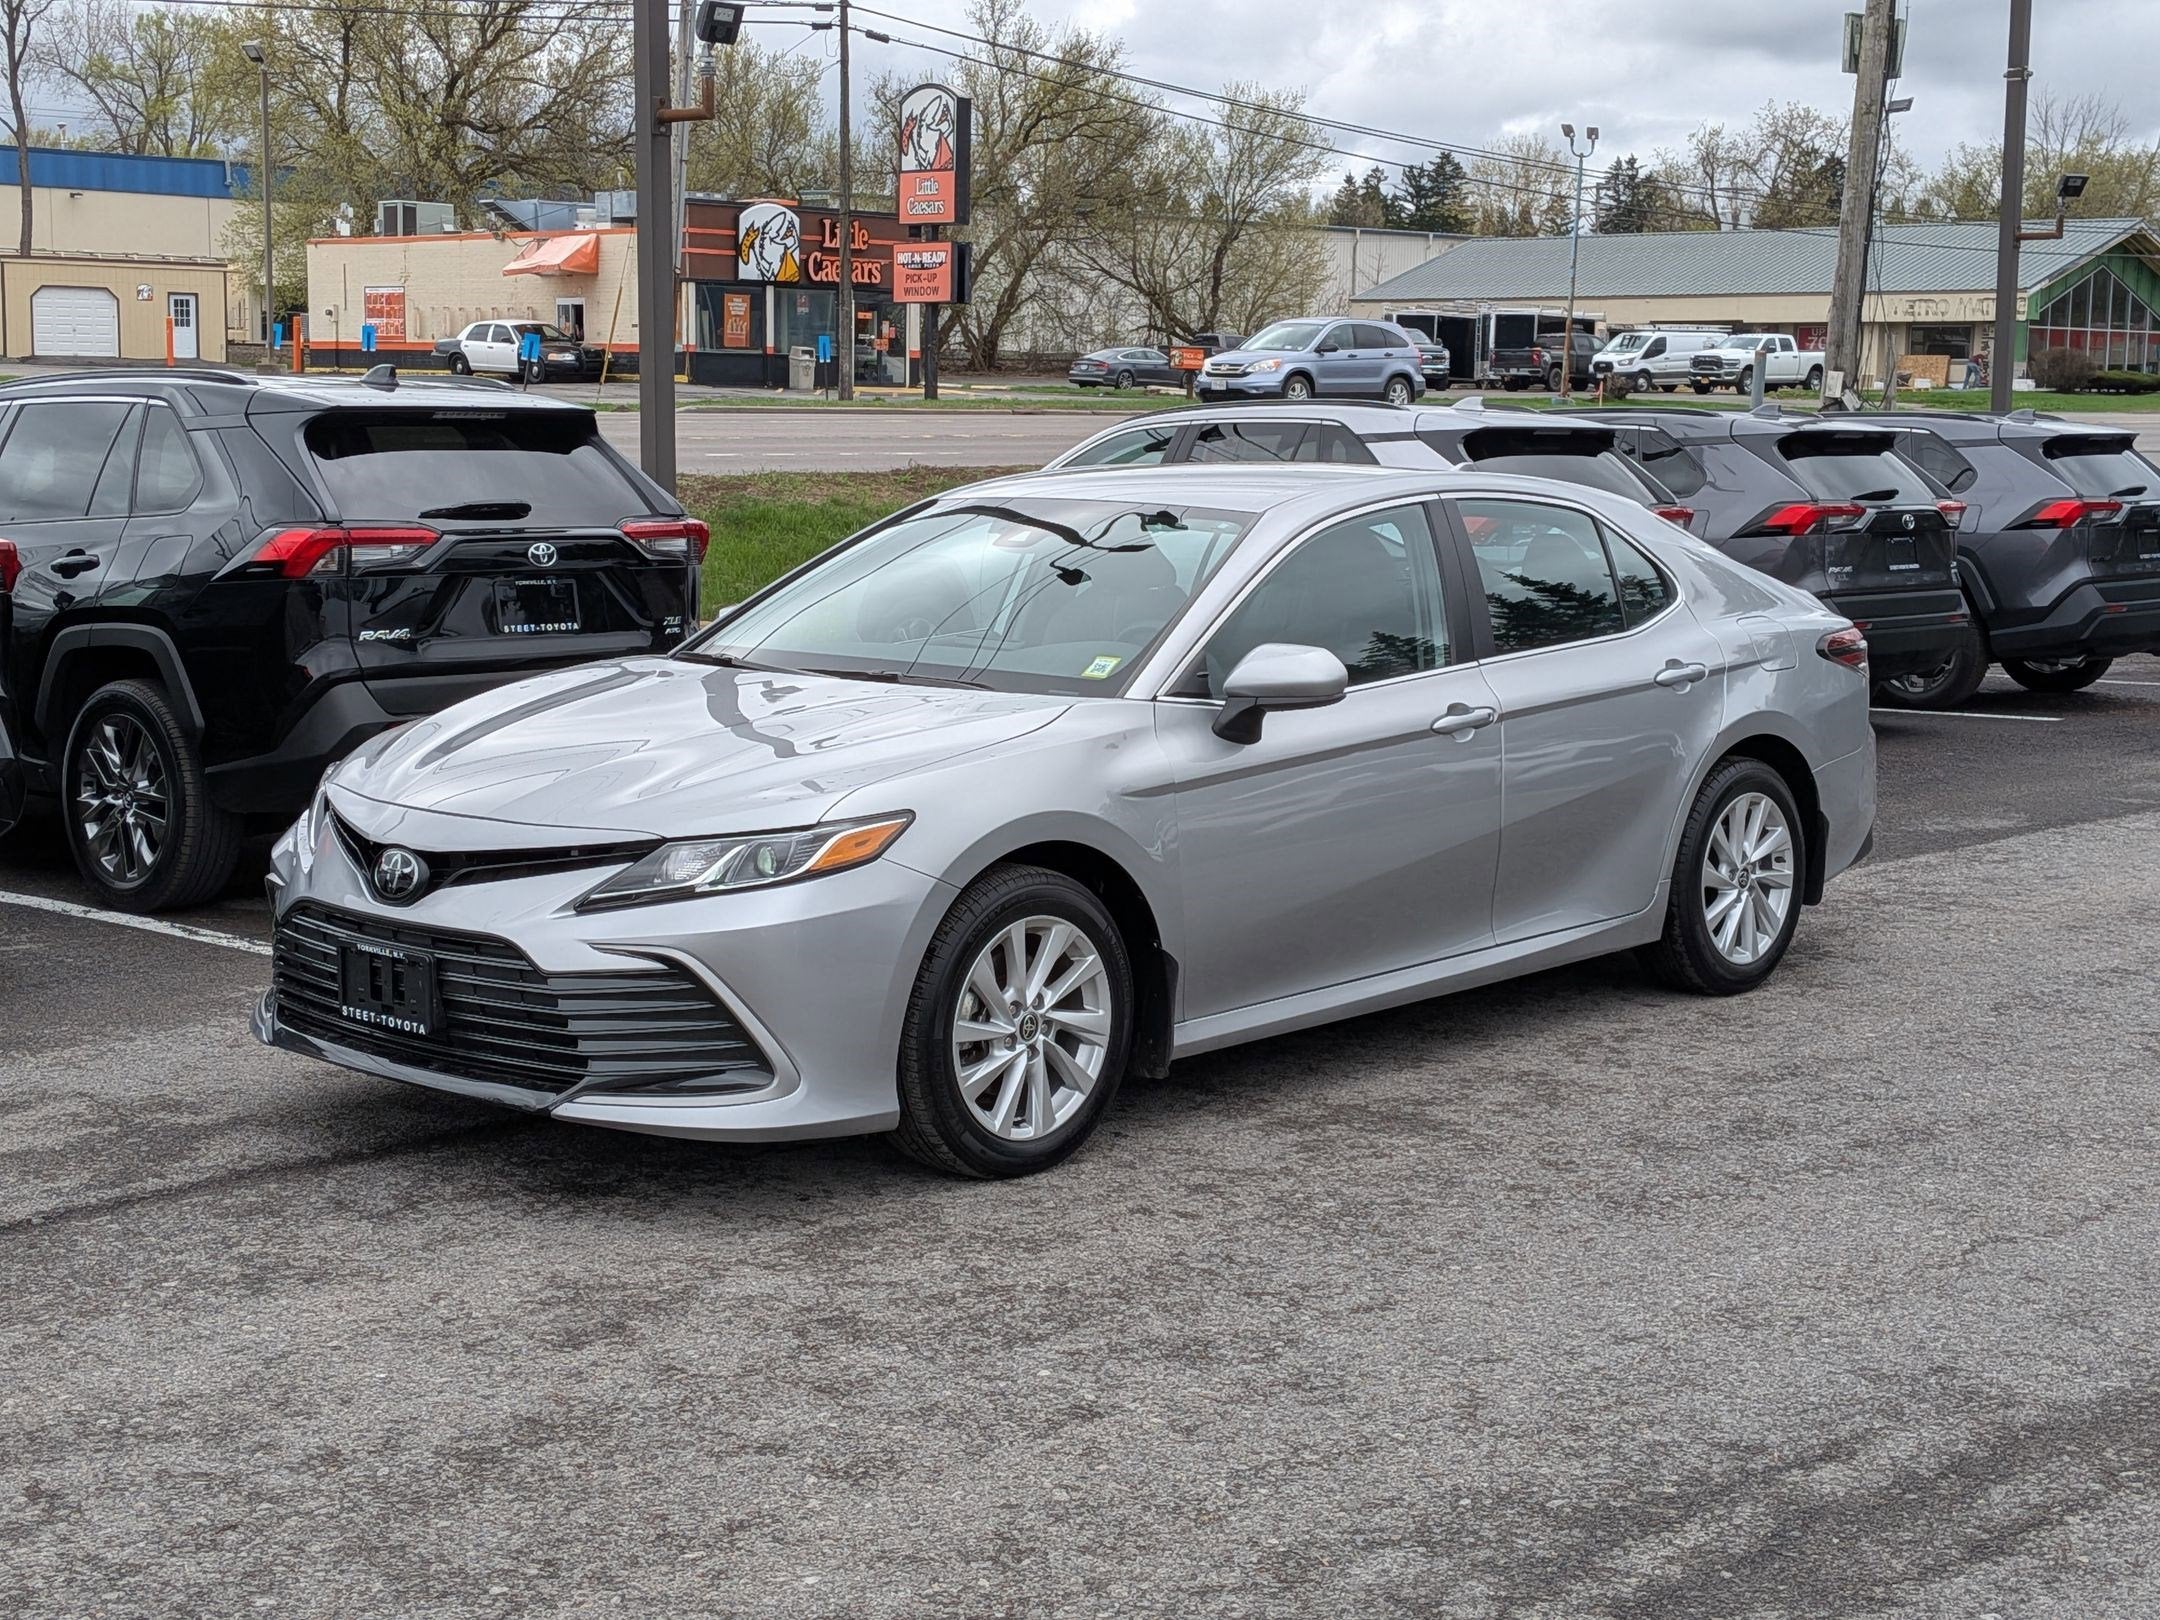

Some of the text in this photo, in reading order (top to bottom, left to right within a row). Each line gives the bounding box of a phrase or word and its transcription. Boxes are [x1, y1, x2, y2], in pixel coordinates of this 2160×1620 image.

[915, 178, 939, 195] Little
[906, 197, 945, 215] Caesars
[822, 219, 869, 250] Lile
[897, 251, 947, 264] HOT-N-READY
[808, 252, 881, 283] Caears
[905, 273, 938, 284] PICK-UP
[903, 286, 940, 297] WINDOW
[1811, 328, 1826, 336] UP
[358, 628, 411, 641] RAV4
